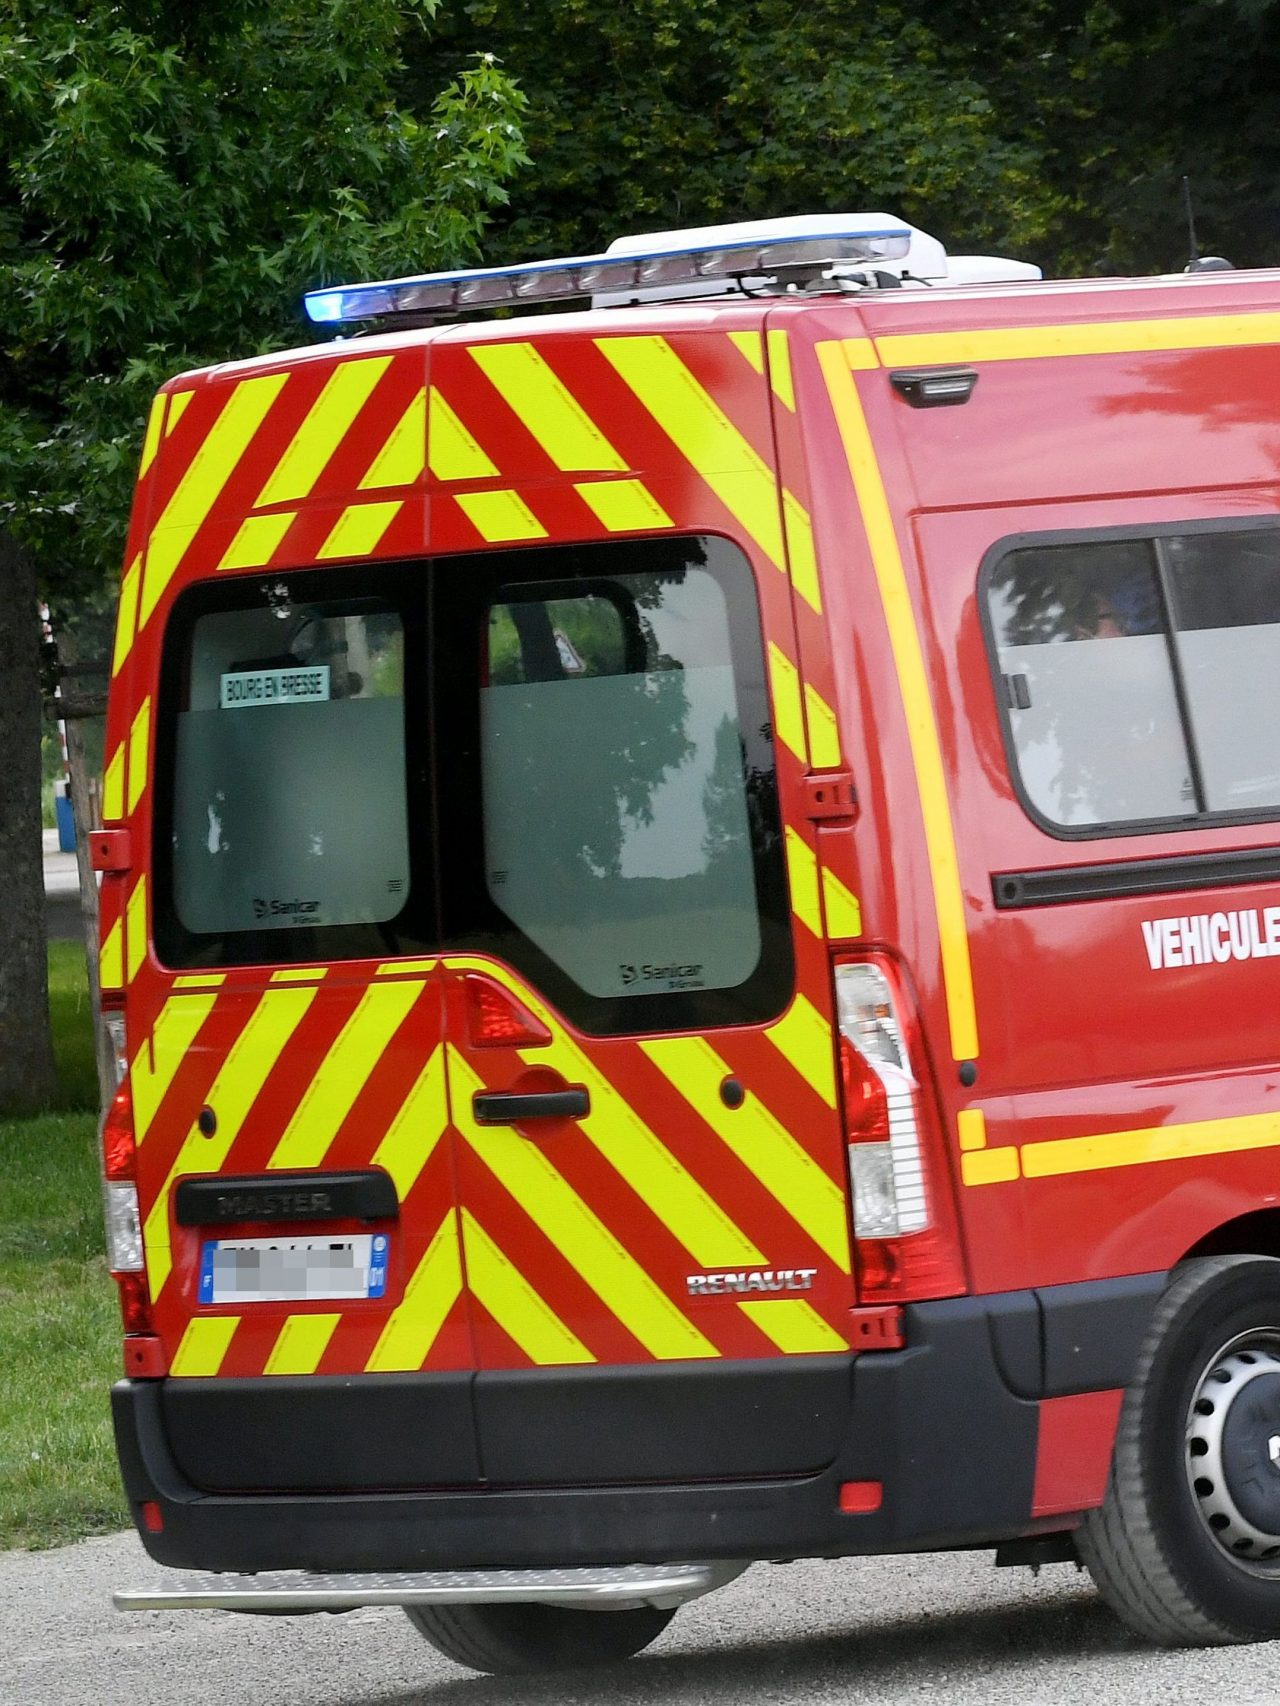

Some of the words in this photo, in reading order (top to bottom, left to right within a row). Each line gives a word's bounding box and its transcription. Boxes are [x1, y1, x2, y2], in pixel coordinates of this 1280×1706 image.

[227, 678, 263, 701] BOURG
[281, 673, 323, 696] BRESSE
[641, 963, 703, 980] Sanicar
[217, 1193, 333, 1216] MASTER
[686, 1268, 818, 1296] RENAULT
